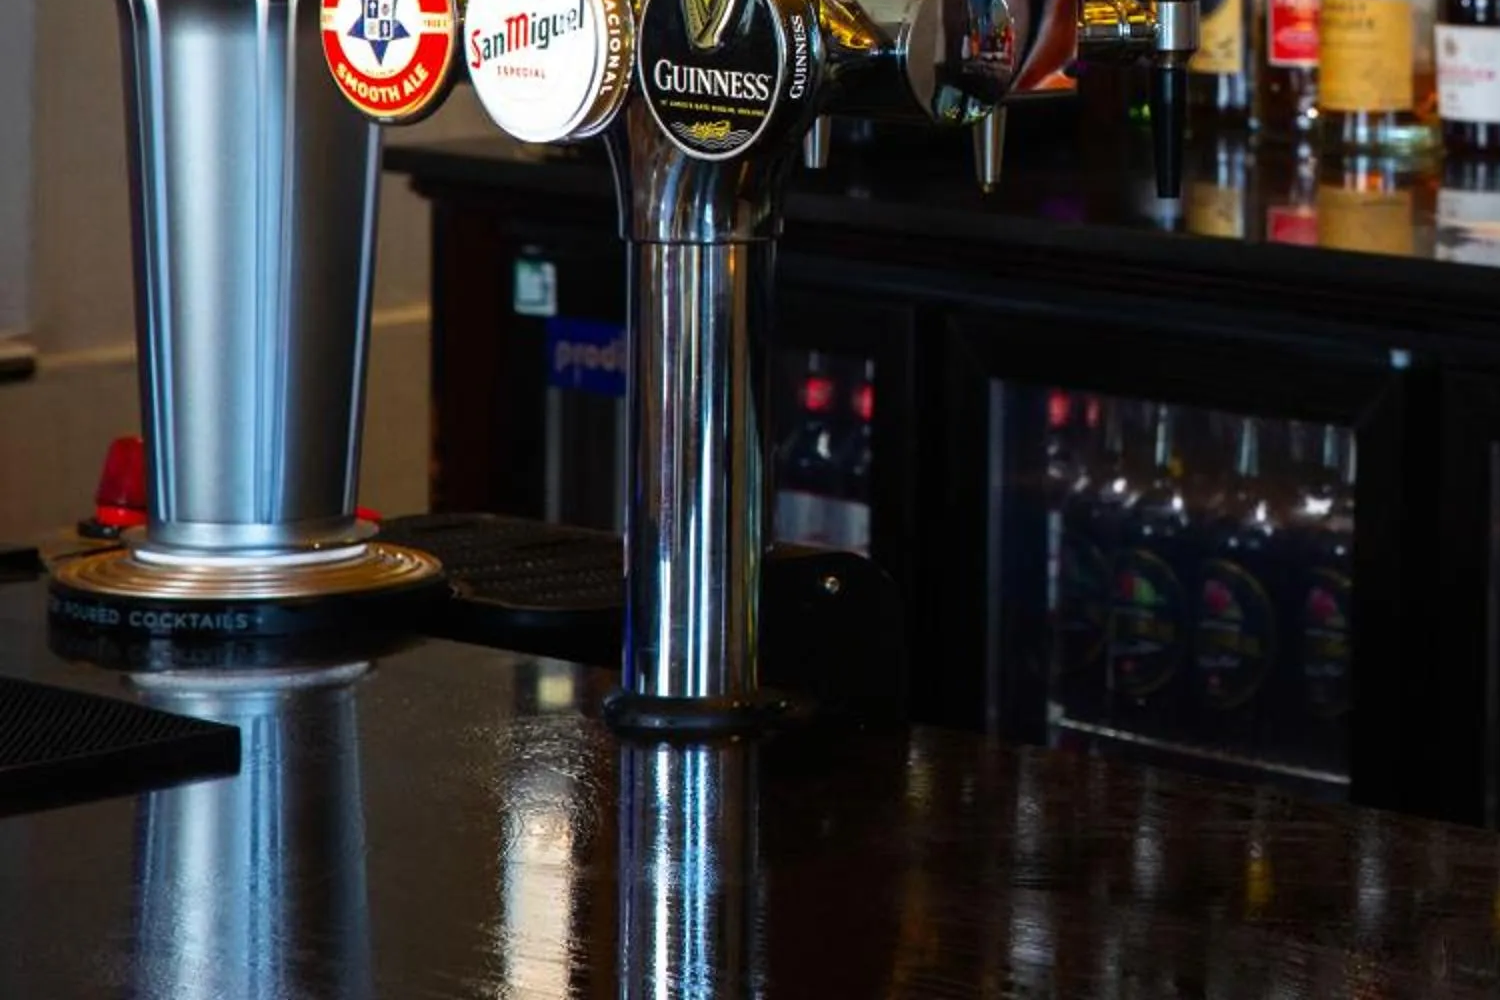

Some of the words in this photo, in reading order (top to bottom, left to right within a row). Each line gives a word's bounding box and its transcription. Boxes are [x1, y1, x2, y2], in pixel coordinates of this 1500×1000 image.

[789, 15, 807, 100] GUINNESS
[335, 62, 400, 104] SMOOTH
[403, 63, 429, 96] ALE
[654, 58, 773, 101] GUINNESS
[128, 611, 249, 630] COCKTAILS
